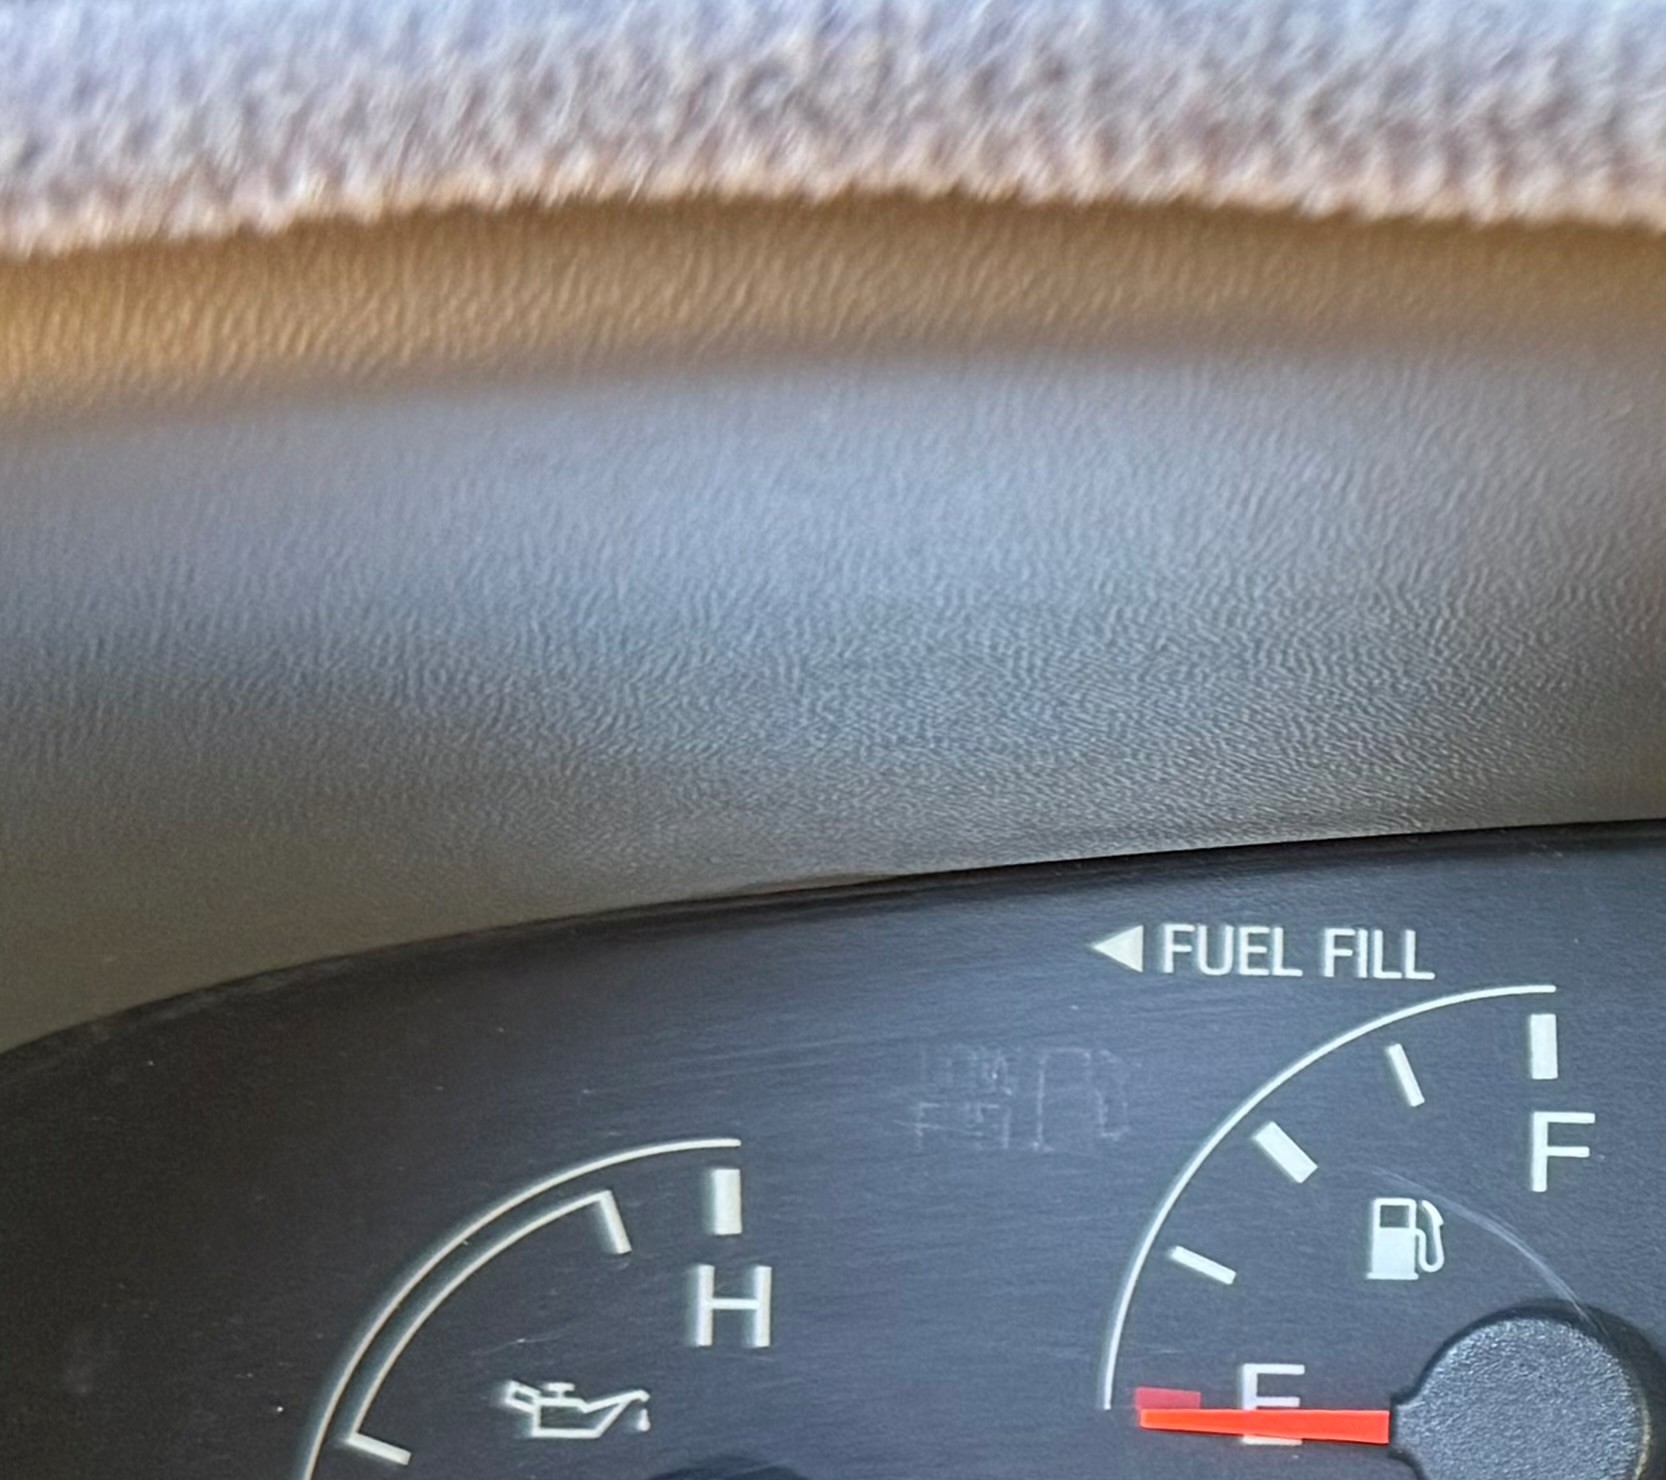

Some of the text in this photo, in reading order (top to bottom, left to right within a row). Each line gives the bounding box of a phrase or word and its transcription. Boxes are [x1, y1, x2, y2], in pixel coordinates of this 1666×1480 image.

[1161, 922, 1436, 981] FUEL FILL
[1529, 1110, 1597, 1194] F
[693, 1263, 773, 1349] H
[1239, 1362, 1306, 1447] E
